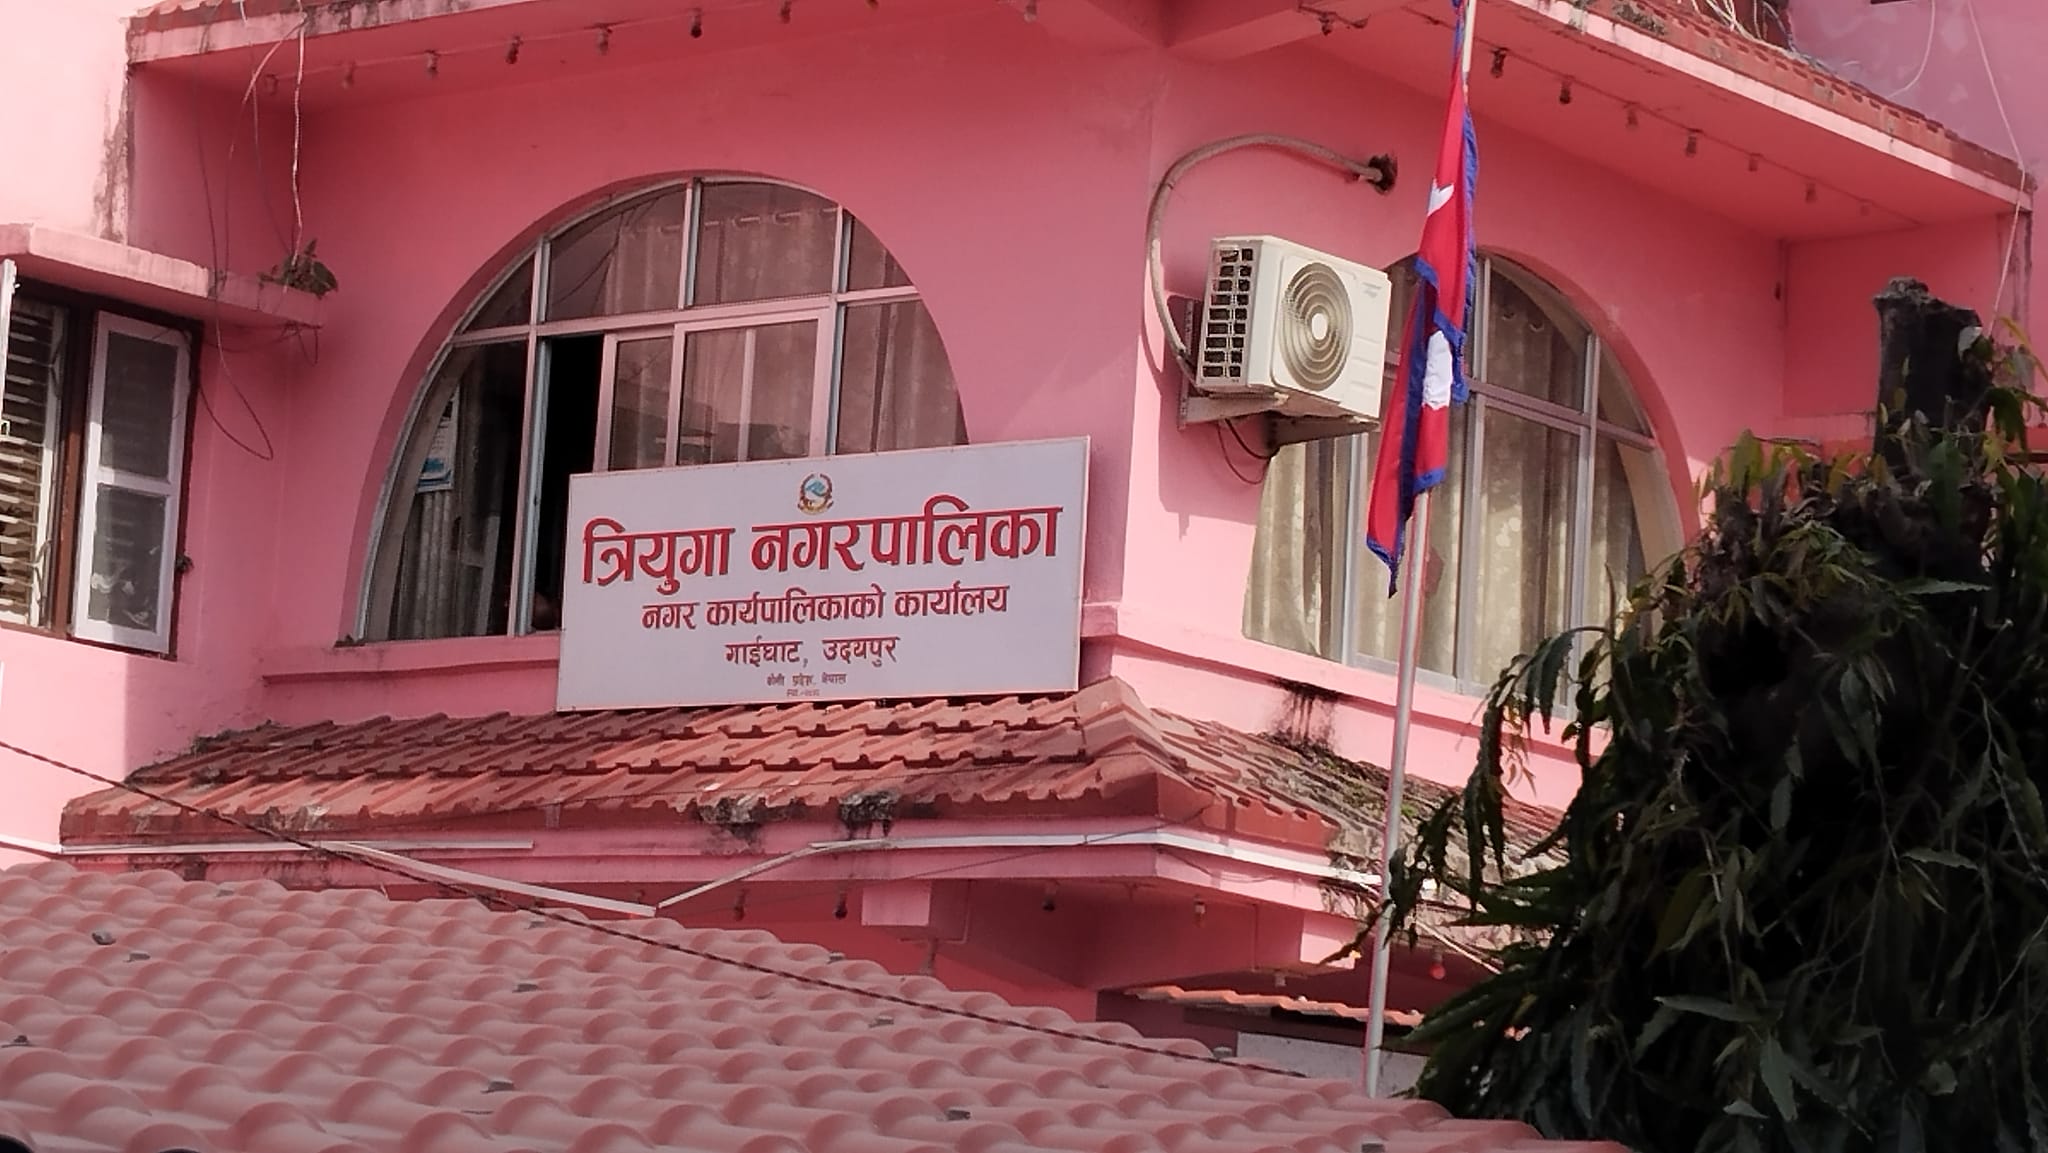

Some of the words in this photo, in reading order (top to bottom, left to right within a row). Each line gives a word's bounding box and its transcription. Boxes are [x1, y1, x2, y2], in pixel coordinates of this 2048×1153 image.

[583, 518, 737, 596] त्रियुगा
[751, 494, 1065, 573] नगरपालिका
[642, 601, 700, 631] नगर
[706, 582, 888, 626] कार्यपालिकाको
[894, 579, 1011, 618] कार्यालय
[724, 635, 809, 669] गाईघाट,
[821, 636, 902, 668] उदयपुर
